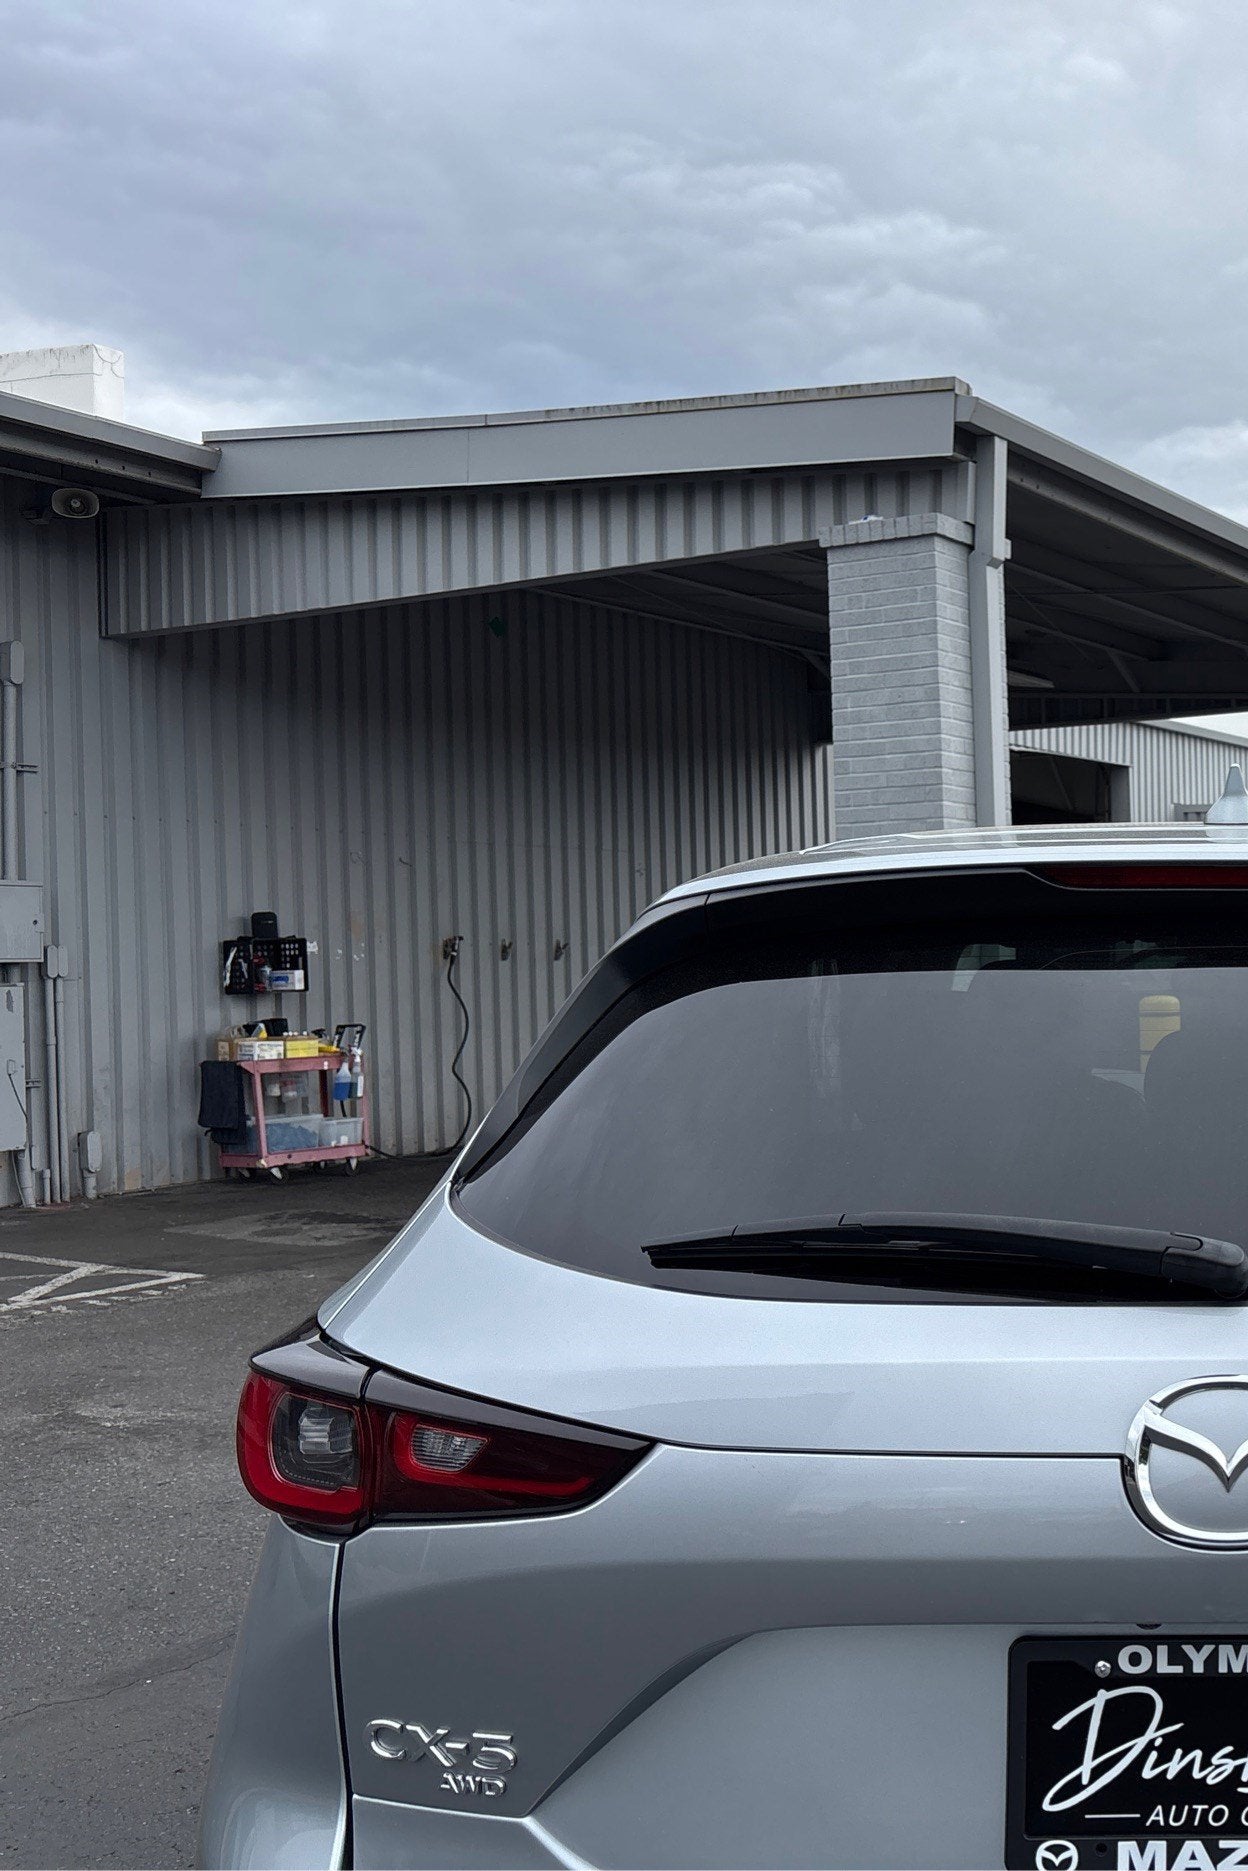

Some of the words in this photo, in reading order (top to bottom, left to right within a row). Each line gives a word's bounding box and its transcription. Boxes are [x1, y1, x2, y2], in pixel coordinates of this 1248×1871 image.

[363, 1717, 518, 1774] CX-5
[440, 1771, 507, 1796] AWD
[1145, 1803, 1230, 1827] AUTO
